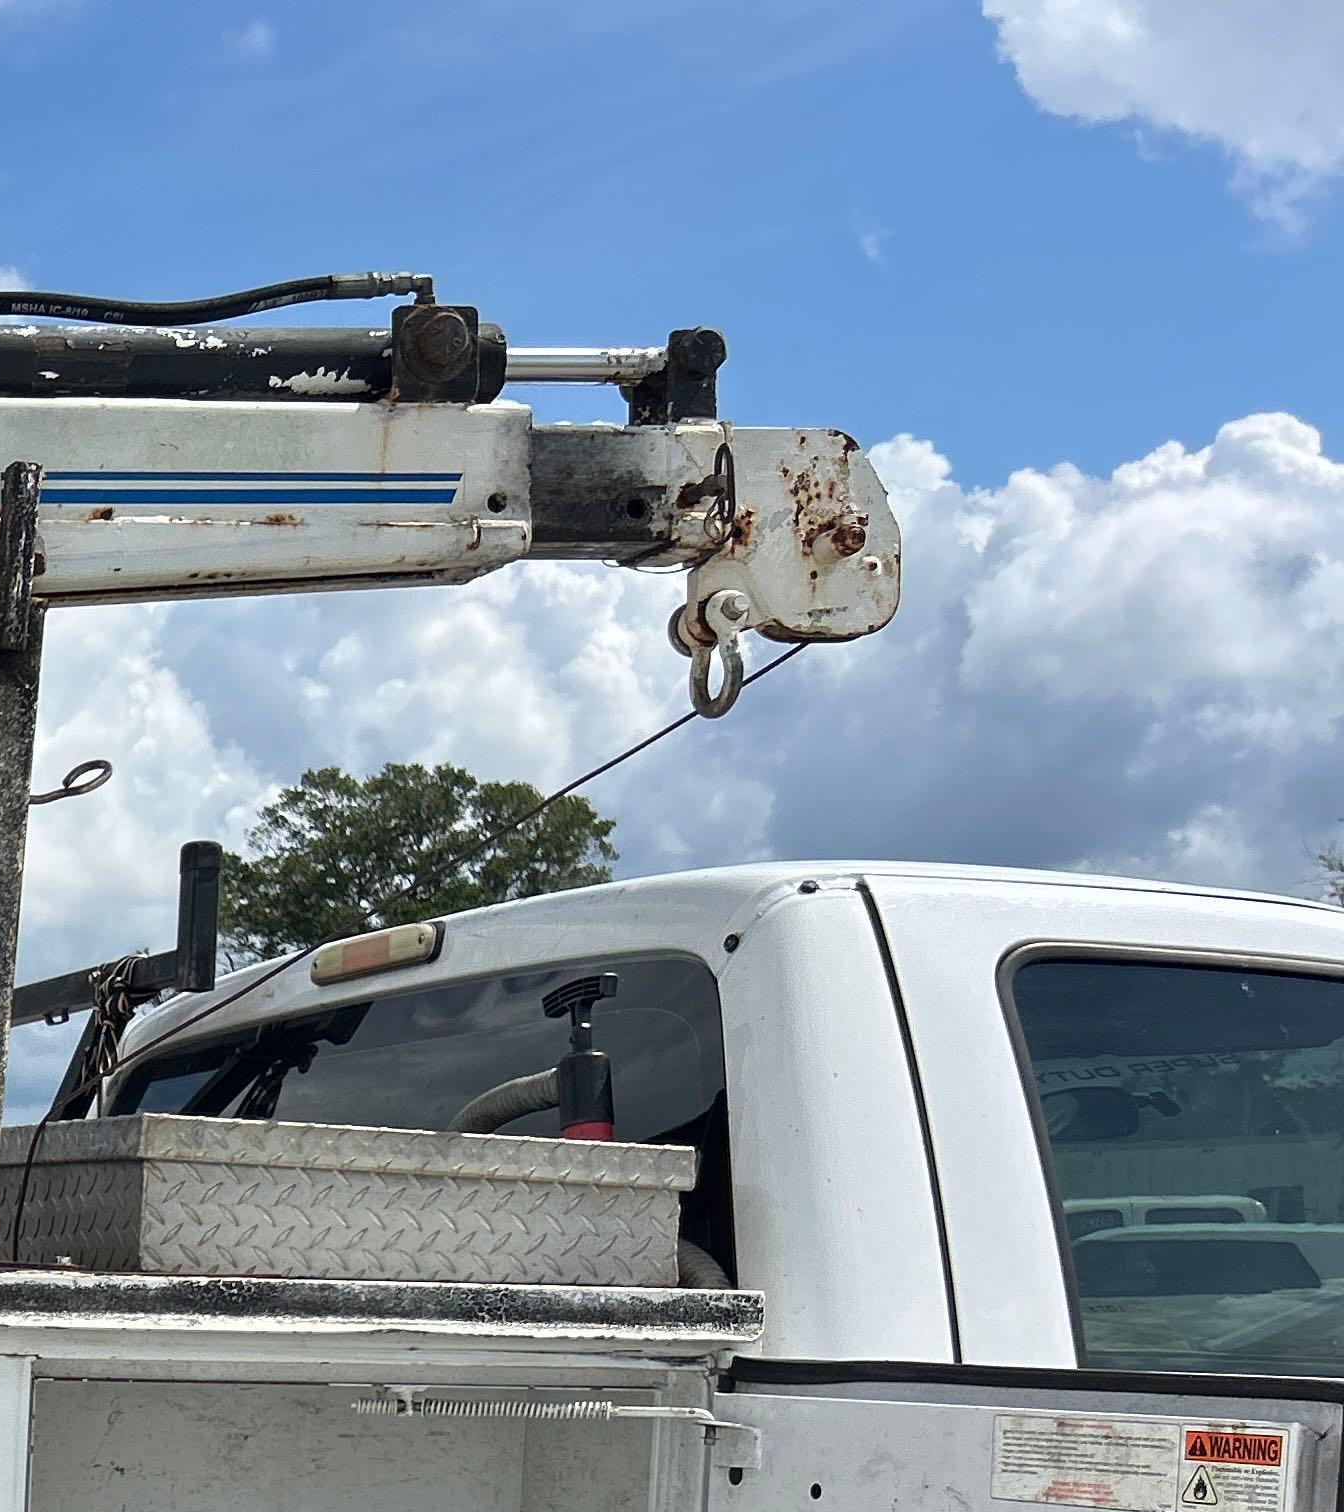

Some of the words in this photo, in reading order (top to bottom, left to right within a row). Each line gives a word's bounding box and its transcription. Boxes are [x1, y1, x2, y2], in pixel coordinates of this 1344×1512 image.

[11, 303, 46, 314] MSHA
[104, 311, 125, 321] CSI
[1208, 1436, 1279, 1462] WARNING
